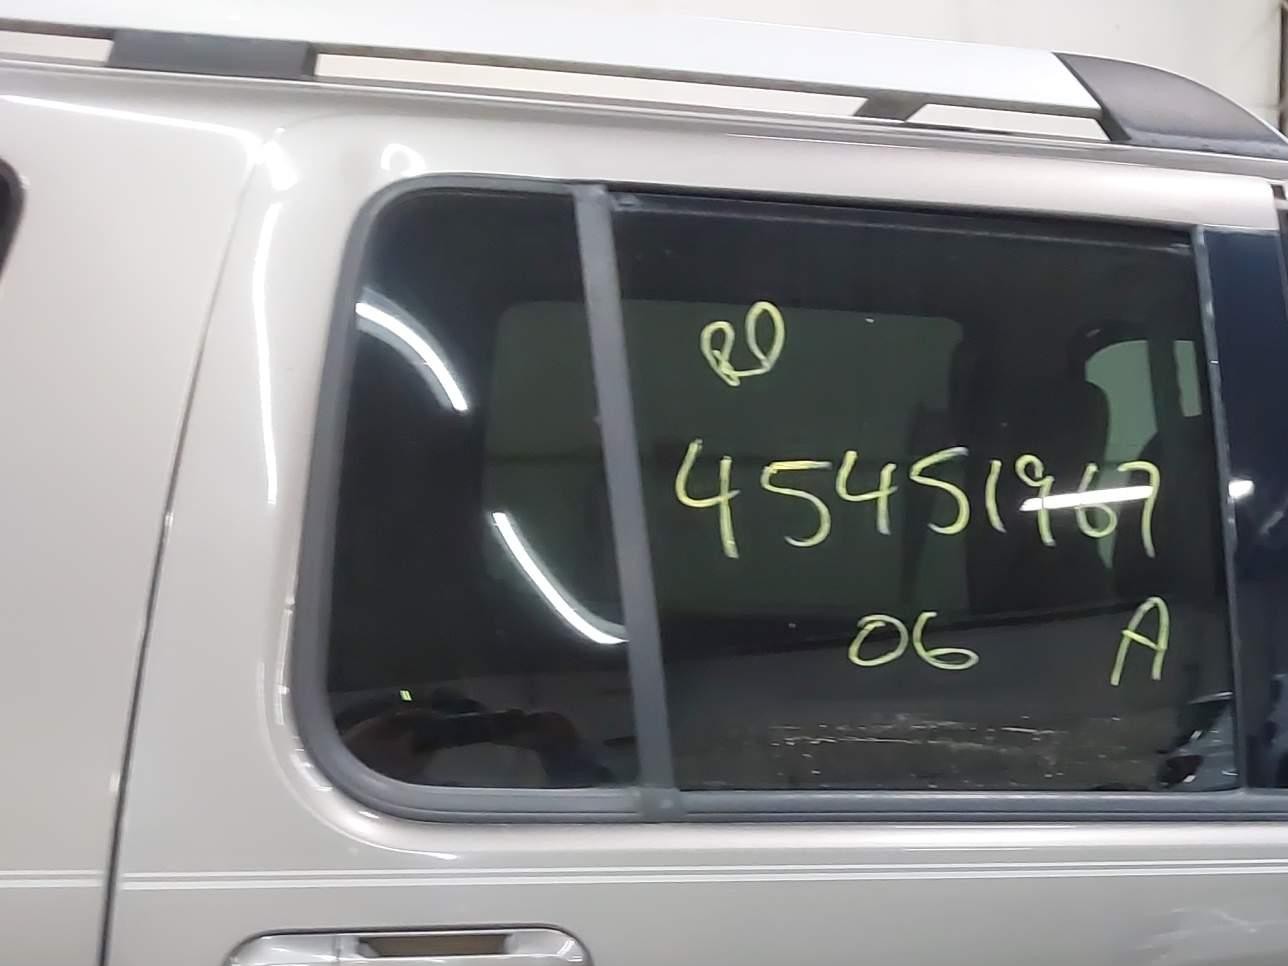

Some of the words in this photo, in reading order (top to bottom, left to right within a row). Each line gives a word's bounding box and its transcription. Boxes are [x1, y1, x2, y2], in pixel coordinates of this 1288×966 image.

[675, 439, 1160, 559] 45451967
[848, 611, 979, 671] 06
[1110, 596, 1170, 686] A
